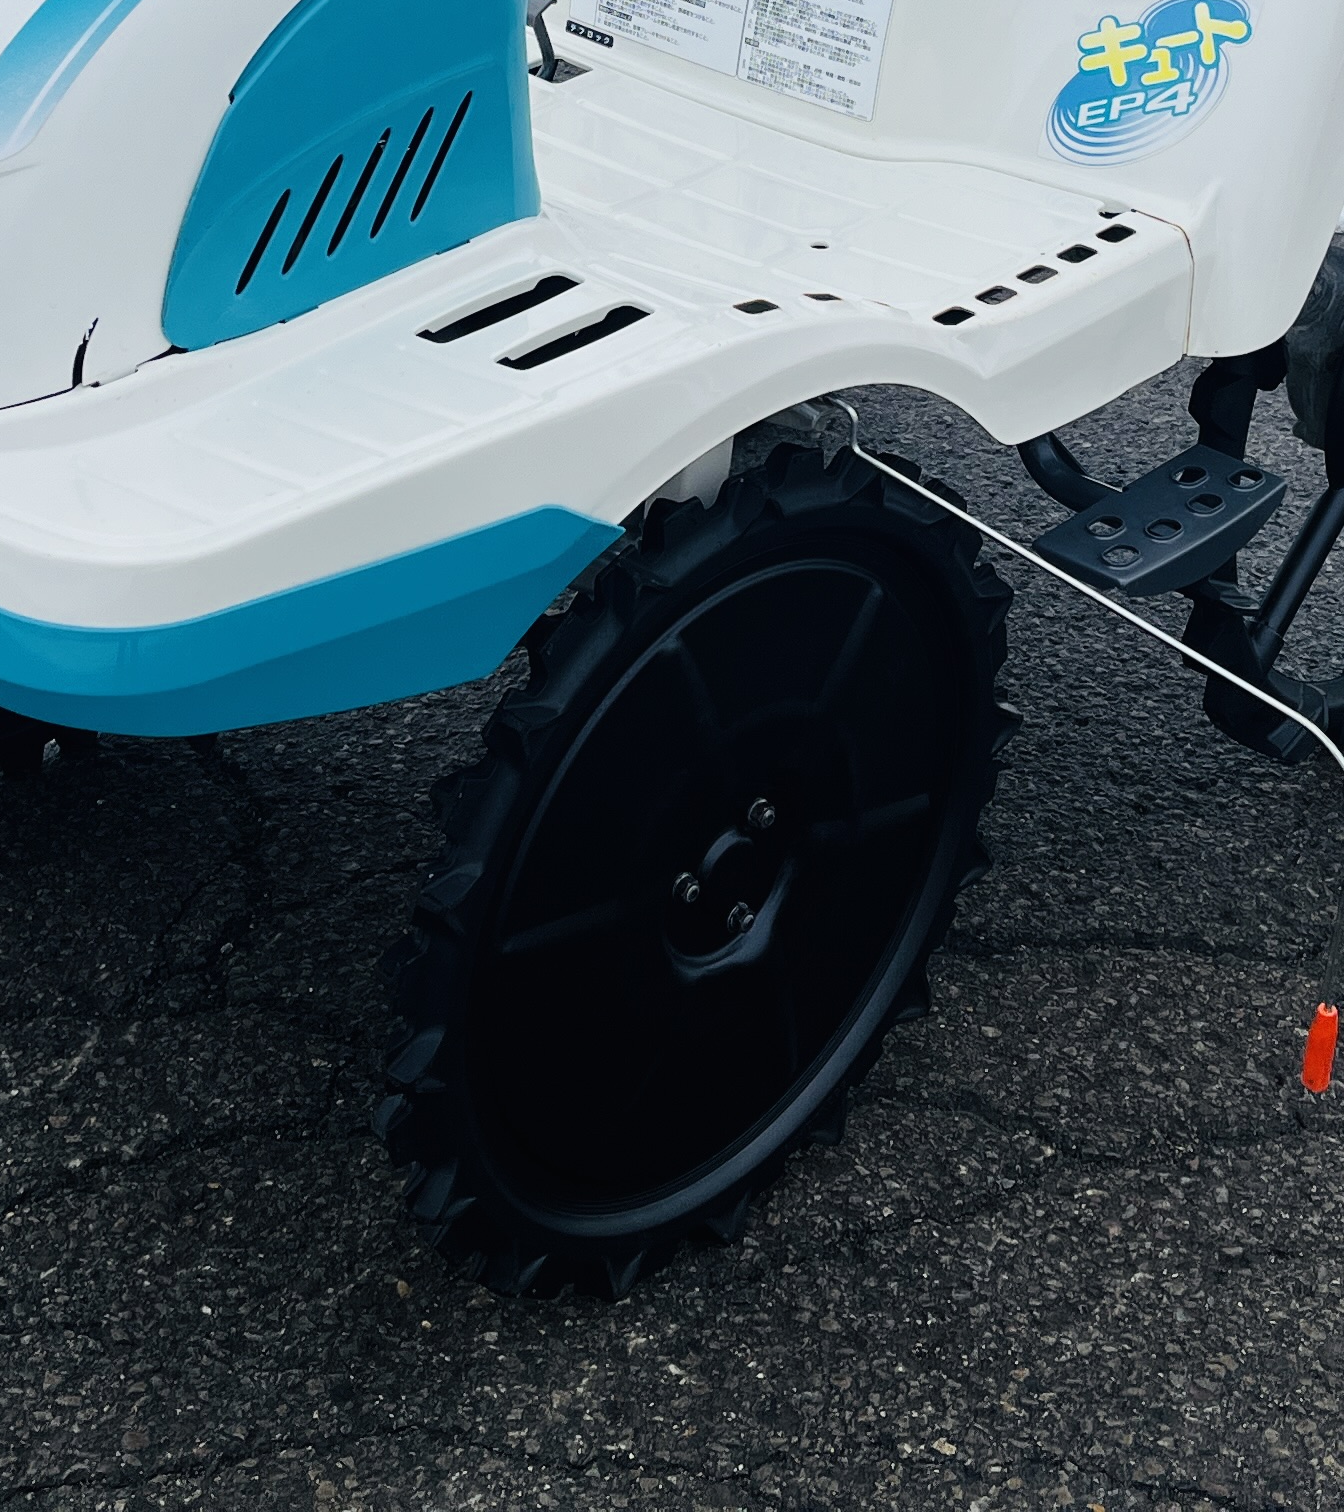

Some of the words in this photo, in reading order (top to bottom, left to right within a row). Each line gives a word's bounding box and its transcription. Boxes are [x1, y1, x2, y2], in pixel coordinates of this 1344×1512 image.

[1078, 0, 1250, 88] キュート
[1076, 80, 1197, 128] EP4
